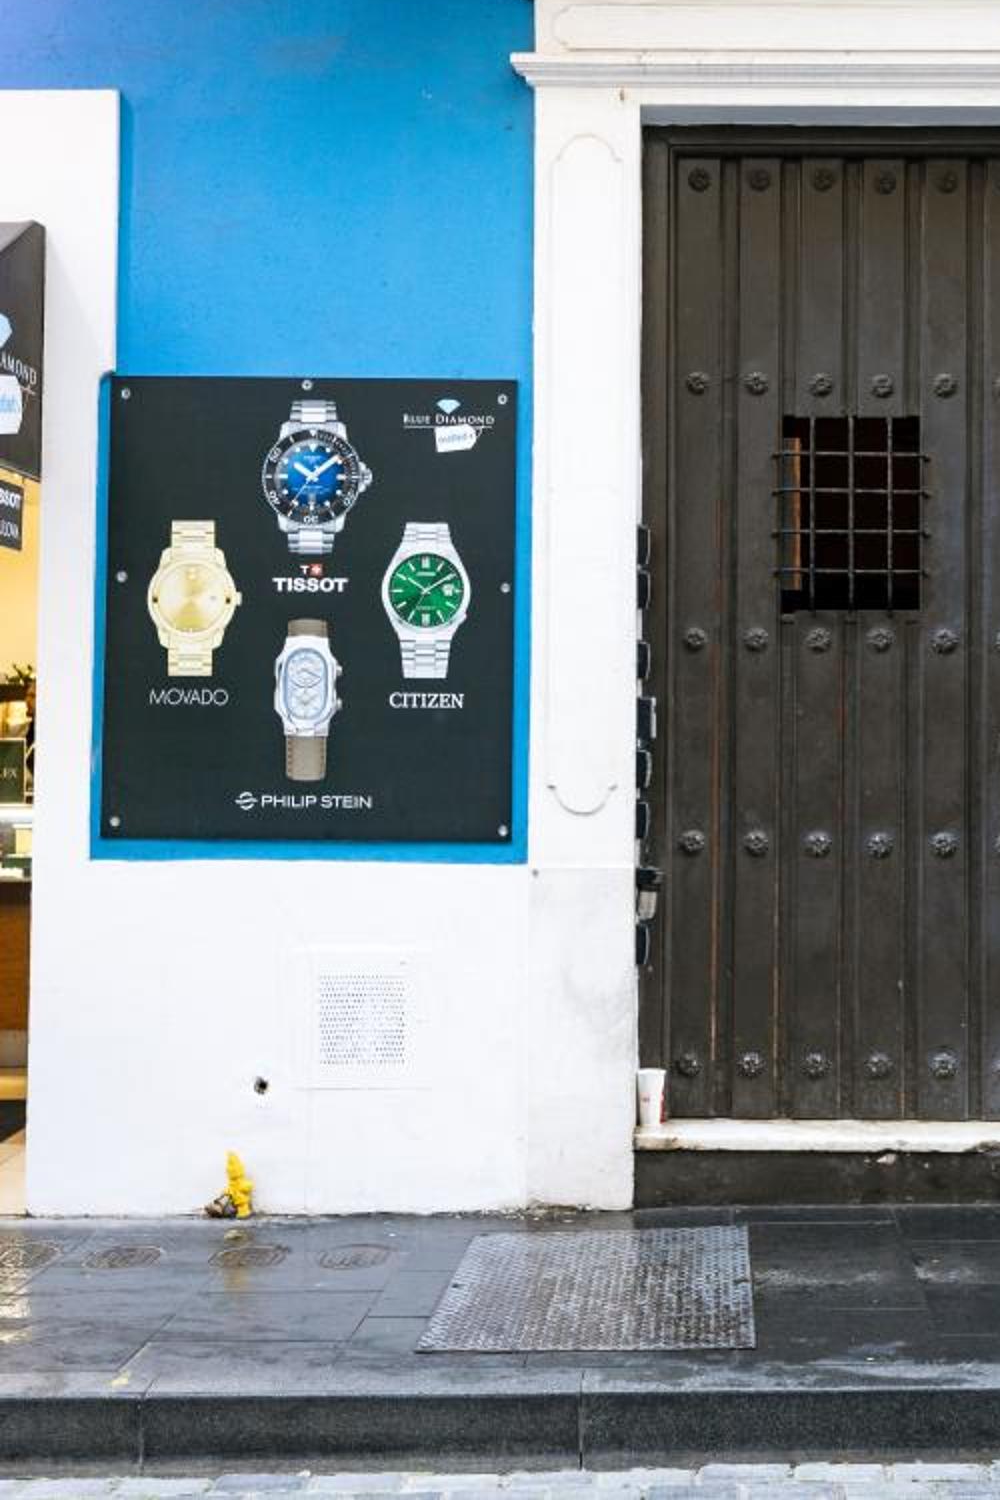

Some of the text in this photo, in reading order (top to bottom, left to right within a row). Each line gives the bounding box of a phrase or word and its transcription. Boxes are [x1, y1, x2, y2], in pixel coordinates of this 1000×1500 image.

[435, 413, 495, 425] DIAMOND
[272, 577, 349, 592] TISSOT
[149, 688, 229, 705] MOVADO
[389, 692, 464, 709] CITIZEN
[261, 795, 373, 809] PHILIP STEIN
